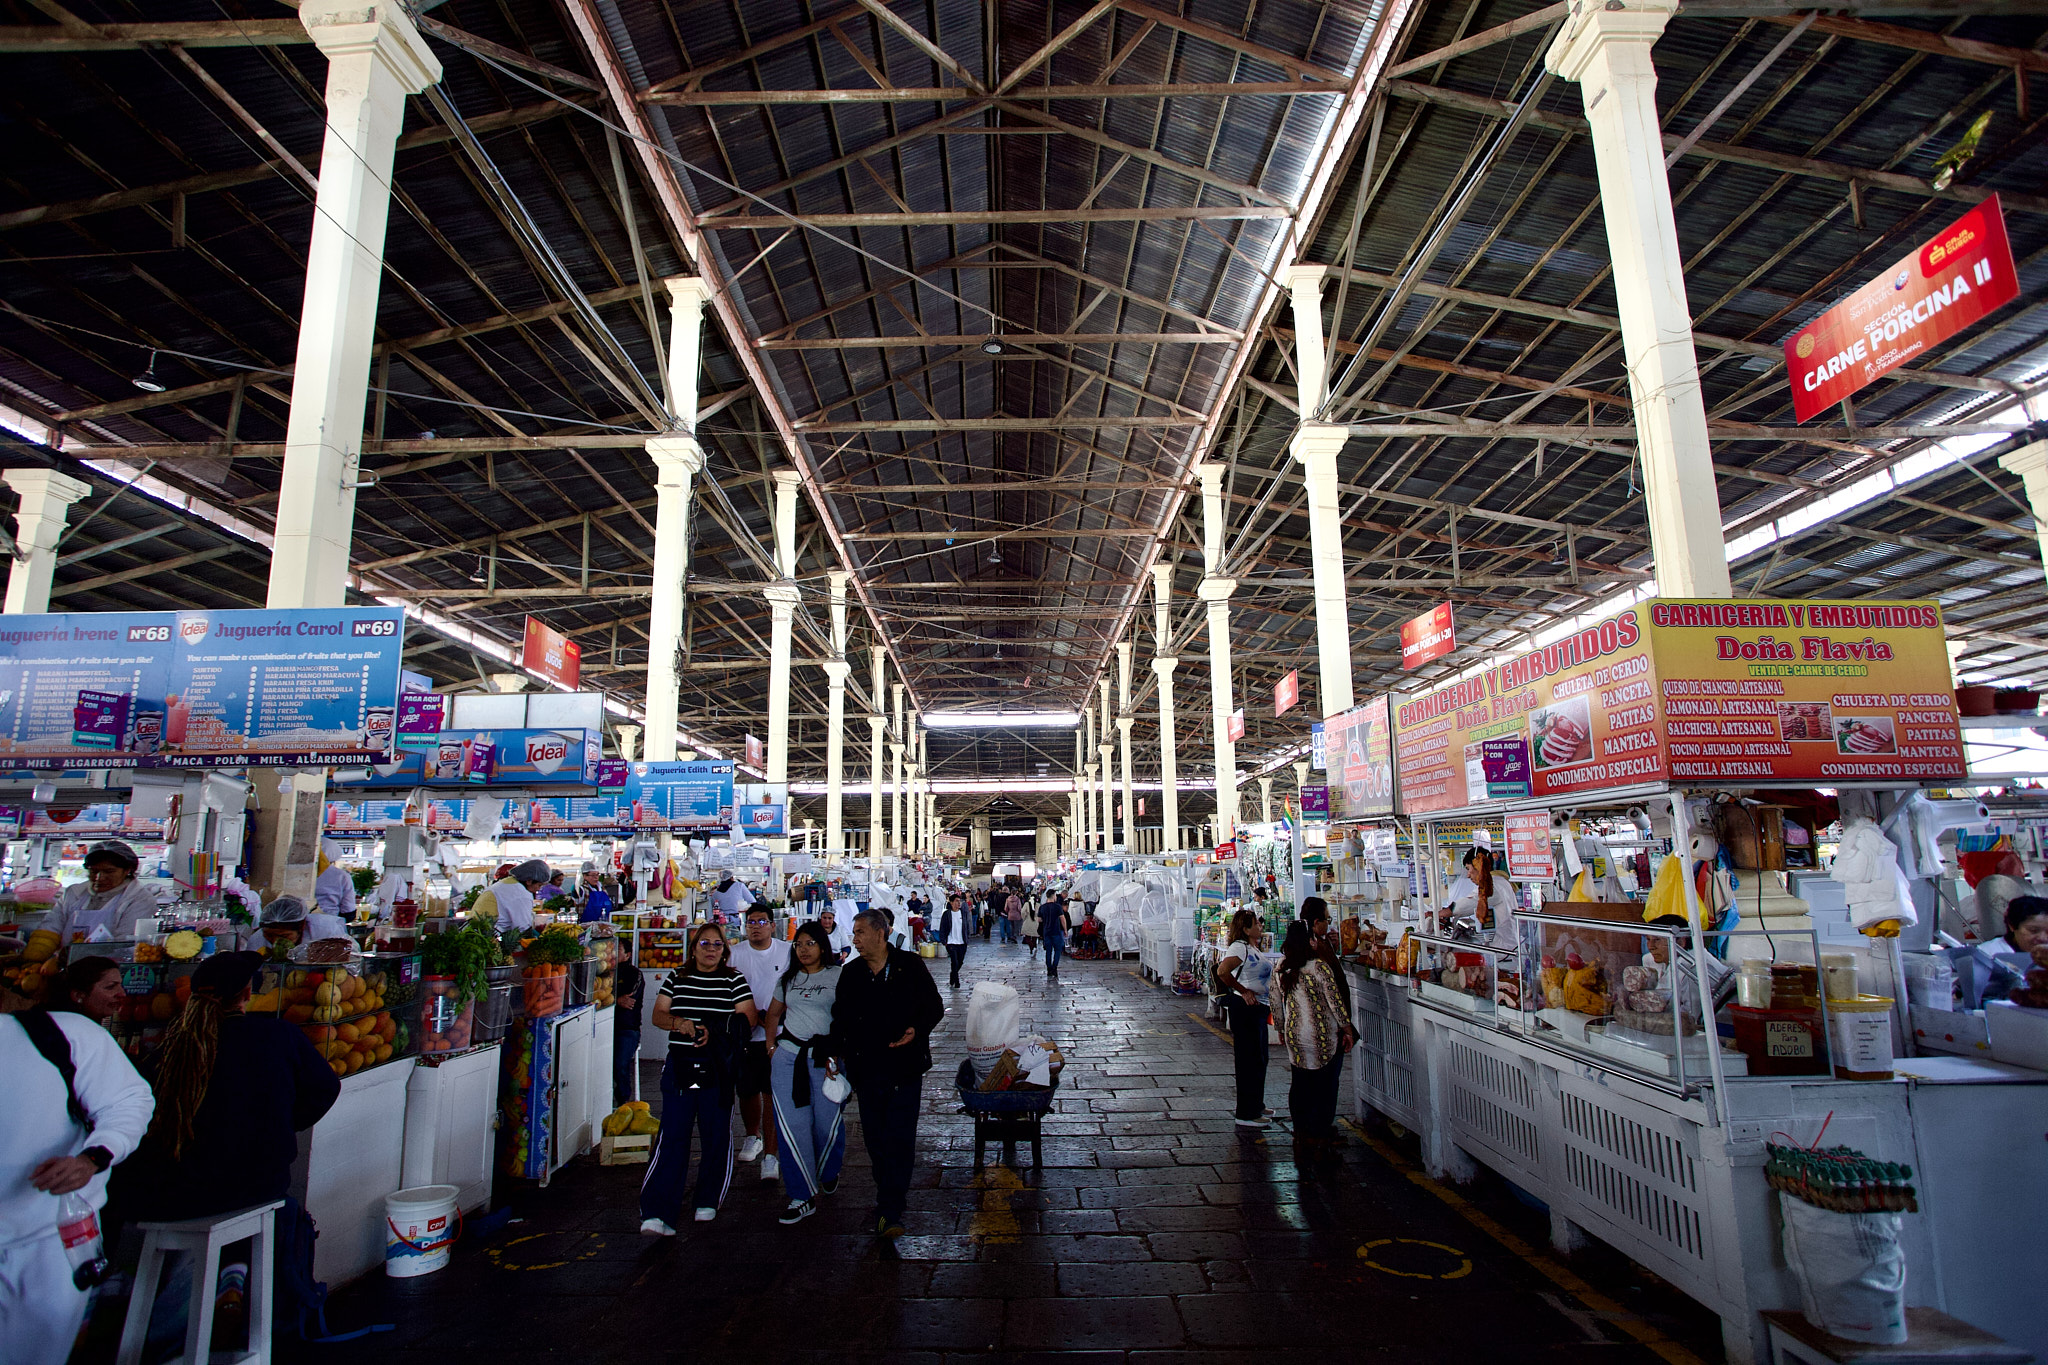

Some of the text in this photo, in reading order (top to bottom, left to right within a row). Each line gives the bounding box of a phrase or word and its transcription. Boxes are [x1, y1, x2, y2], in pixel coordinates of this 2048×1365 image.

[1945, 229, 1968, 249] CAJA
[1946, 232, 1975, 255] CUSCO
[1803, 338, 1867, 392] CARNE
[1870, 275, 1971, 352] PORCINA
[1973, 257, 1992, 286] II
[1863, 301, 1907, 334] SECCIÓN
[1652, 604, 1939, 628] CARNICERIA Y EMBUTIDOS
[74, 627, 118, 641] Irene
[179, 622, 209, 637] Ideal
[215, 621, 289, 641] Juguería
[296, 621, 343, 636] Carol
[1403, 642, 1420, 658] CARNE
[1419, 632, 1442, 651] PORCINA
[1715, 636, 1894, 661] Doña Flavia
[80, 657, 101, 665] fruits
[119, 657, 135, 665] you
[136, 656, 154, 664] like!
[187, 654, 202, 662] You
[297, 652, 307, 660] of
[307, 652, 329, 660] fruits
[347, 653, 363, 661] you
[363, 651, 382, 659] like!
[1399, 672, 1485, 729] CARNICERIA
[1483, 670, 1498, 696] Y
[1500, 610, 1640, 692] EMBUTIDOS
[1748, 665, 1777, 676] VENTA
[1794, 665, 1823, 676] CARNE
[1824, 665, 1836, 676] DE
[1837, 665, 1868, 676] CERDO
[1553, 655, 1648, 699] CHULETA DE CERDO
[1601, 680, 1652, 708] PANCETA
[1663, 681, 1784, 697] QUESO DE CHANCHO ARTESANAL
[81, 693, 100, 701] PAGA
[423, 695, 441, 703] AQUÍ
[1832, 695, 1950, 707] CHULETA DE CERDO
[1456, 687, 1538, 731] Doña Flavia
[1665, 701, 1777, 715] JAMONADA ARTESANAL
[93, 715, 115, 728] yape
[399, 714, 420, 728] yape
[1608, 704, 1655, 730] PATITAS
[1898, 712, 1953, 724] PANCETA
[1667, 722, 1774, 736] SALCHICHA ARTESANAL
[1906, 729, 1956, 741] PATITAS
[1603, 730, 1658, 755] MANTECA
[1670, 743, 1792, 756] TOCINO AHUMADO ARTESANAL
[438, 750, 461, 761] Ideal
[525, 743, 567, 763] Ideal
[1900, 746, 1959, 758] MANTECA
[26, 759, 51, 768] MIEL
[173, 757, 204, 766] MACA
[260, 756, 285, 764] MIEL
[651, 765, 686, 776] Juguería
[687, 766, 708, 774] Edith
[1503, 762, 1521, 777] yape
[1546, 755, 1661, 787] CONDIMENTO ESPECIAL
[1672, 762, 1774, 775] MORCILLA ARTESANAL
[1821, 763, 1962, 775] CONDIMENTO ESPECIAL
[753, 812, 775, 824] Ideal
[1772, 1044, 1806, 1056] ADOBO
[429, 1221, 445, 1230] CPP
